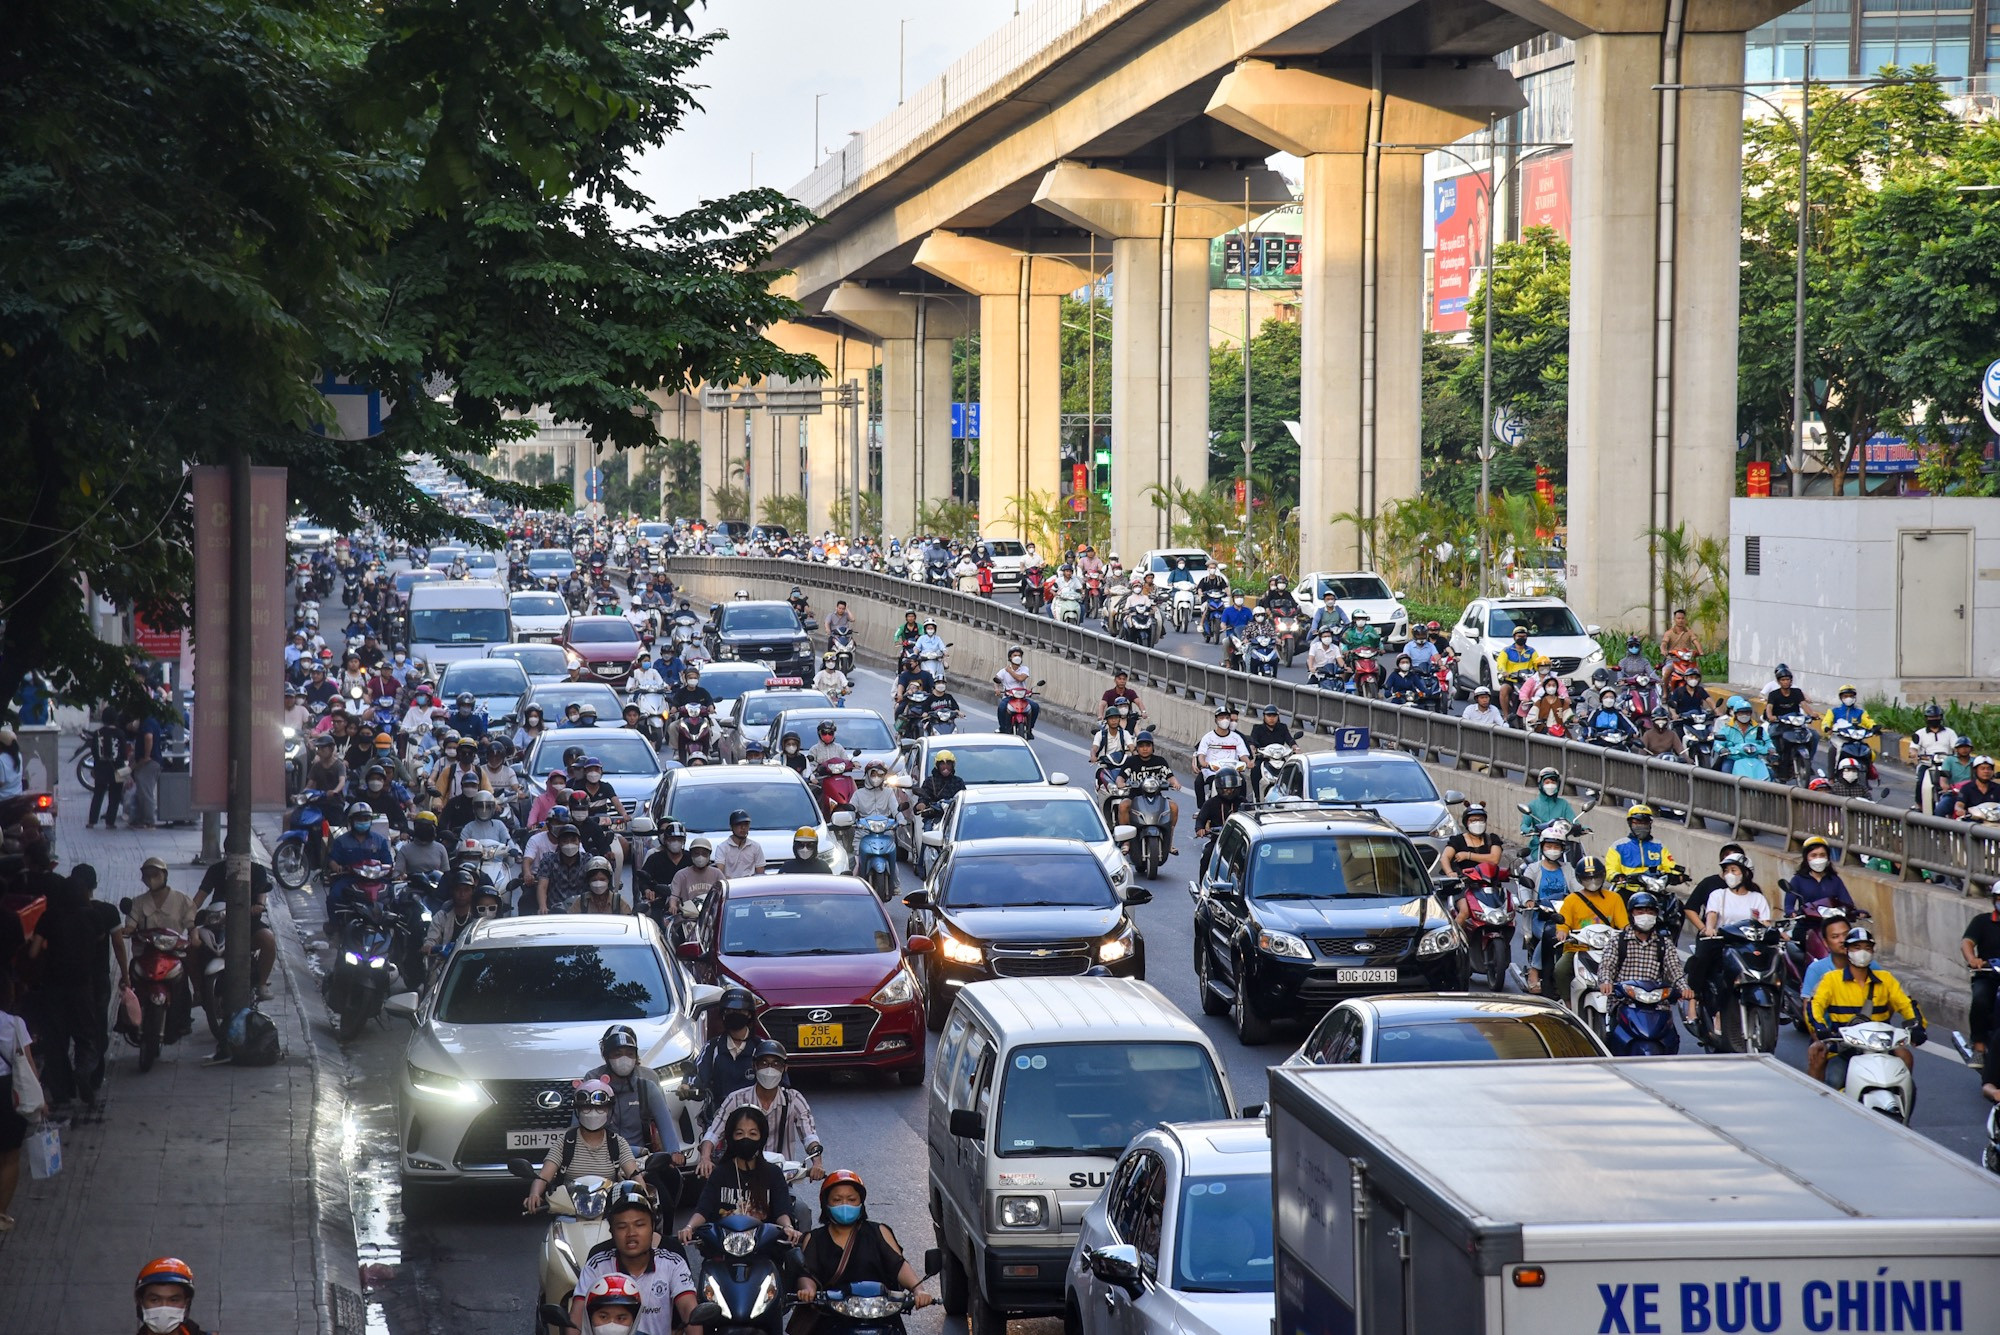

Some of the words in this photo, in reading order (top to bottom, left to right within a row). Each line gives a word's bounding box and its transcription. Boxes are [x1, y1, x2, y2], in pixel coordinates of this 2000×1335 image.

[1751, 468, 1766, 476] 2-9
[1647, 850, 1660, 860] be
[1338, 970, 1396, 982] 30G-029.19
[811, 1026, 830, 1036] 29E
[803, 1036, 838, 1046] 020.24
[514, 1133, 564, 1146] 30H-79
[999, 1178, 1046, 1186] CARRY
[1597, 1283, 1661, 1334] XE
[1680, 1276, 1781, 1333] BƯU
[1801, 1266, 1963, 1333] CHÍNH
